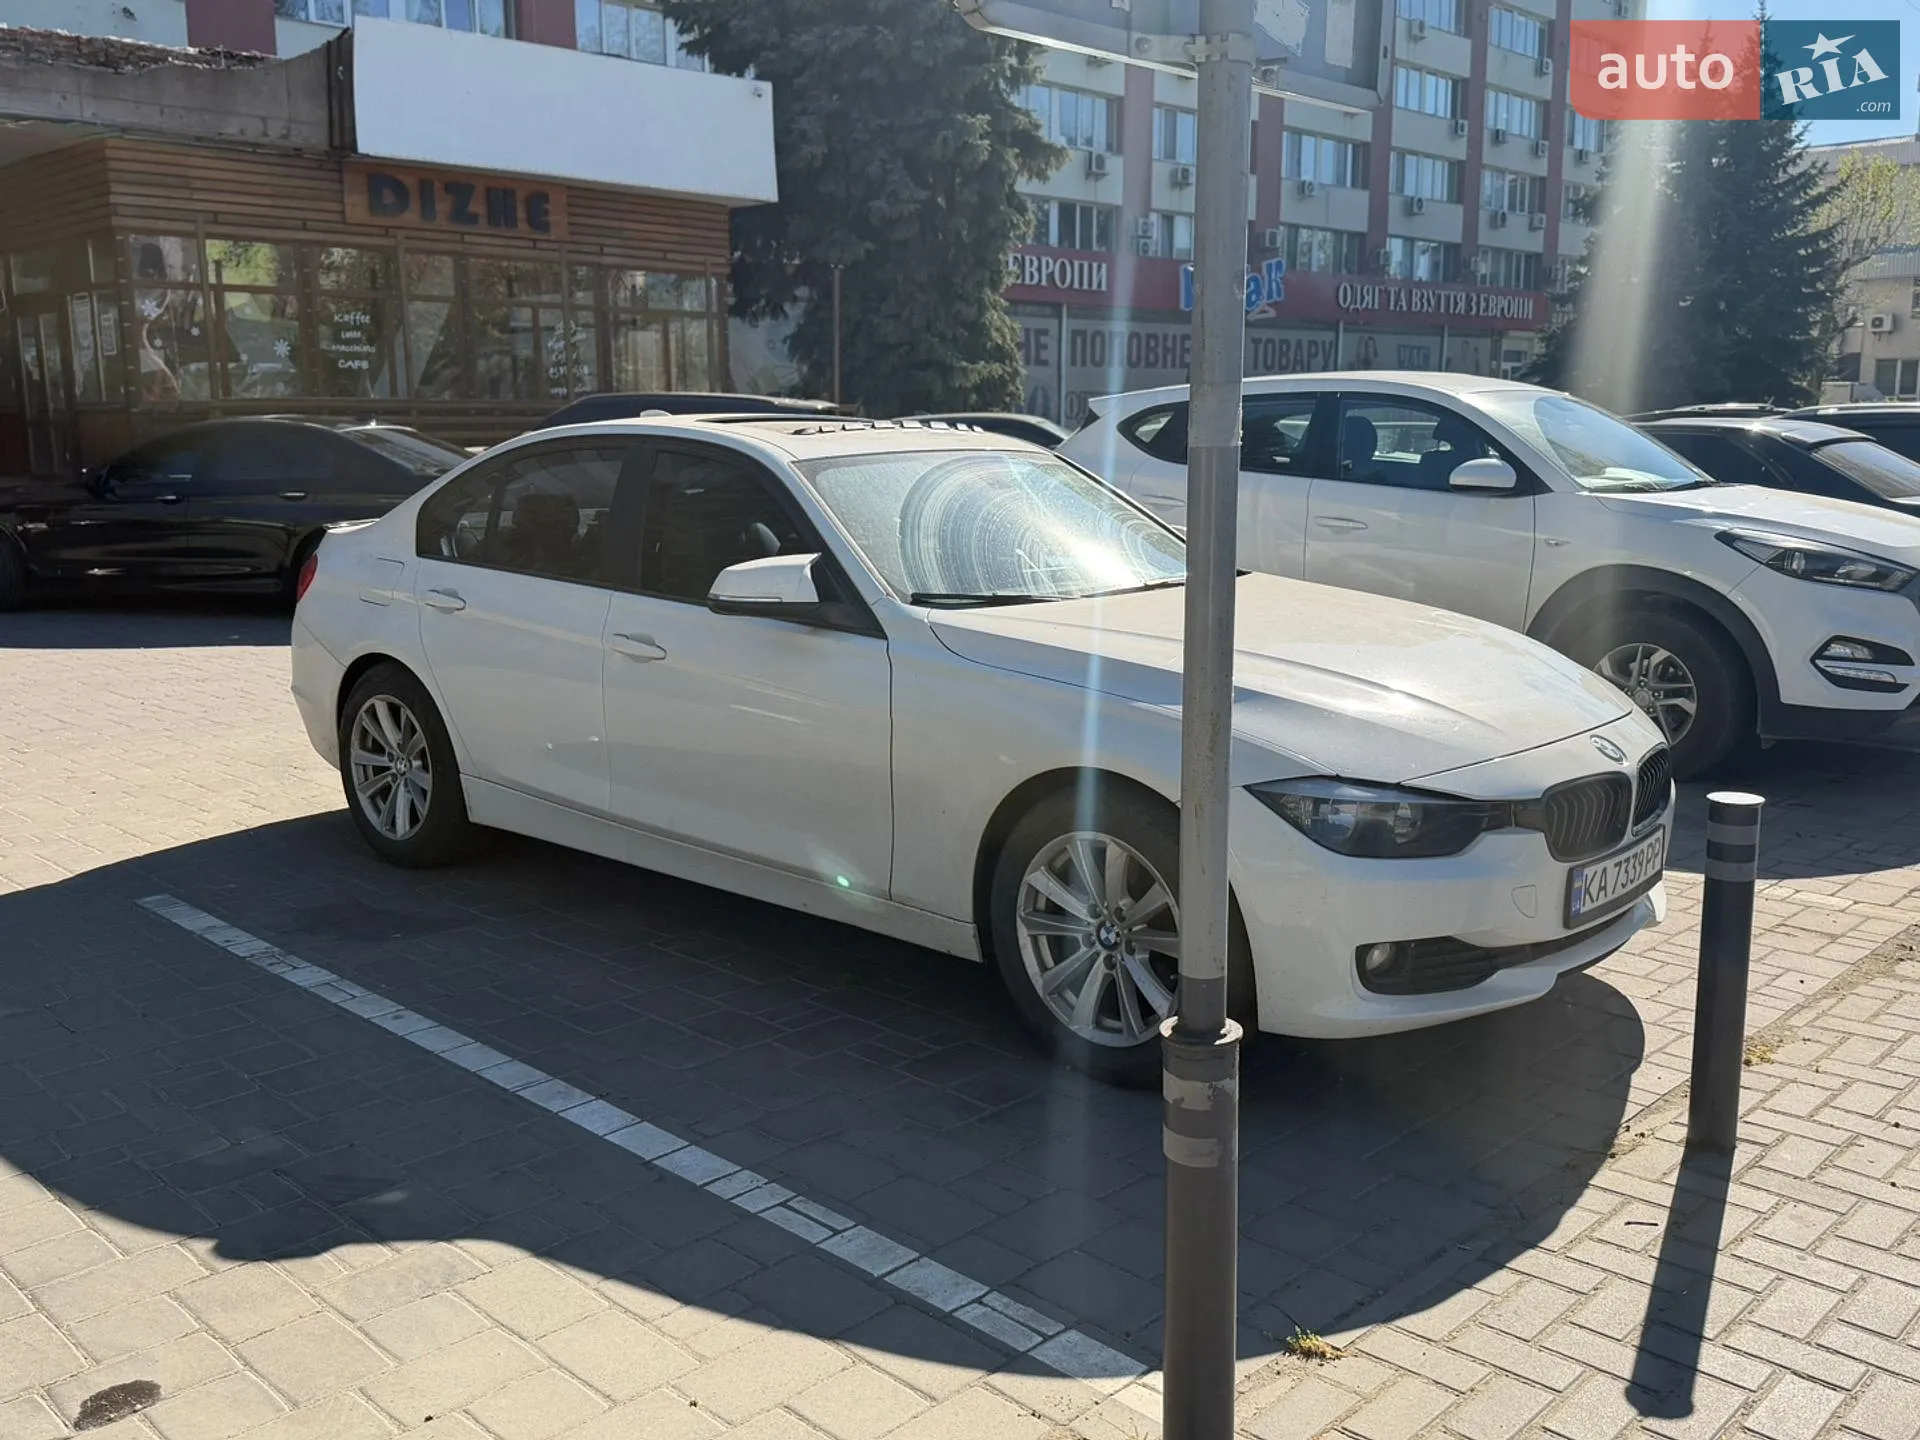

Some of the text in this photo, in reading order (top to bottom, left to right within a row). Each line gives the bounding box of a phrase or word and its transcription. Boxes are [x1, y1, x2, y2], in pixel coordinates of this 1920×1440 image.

[1338, 282, 1385, 311] ОДЯГ
[1388, 285, 1406, 312] ТА
[1411, 288, 1466, 315] ВЗУТТЯ
[1251, 337, 1335, 373] ТОВАРУ
[1582, 866, 1607, 907] KA
[1611, 847, 1645, 895] 7339
[1644, 836, 1662, 873] PP
